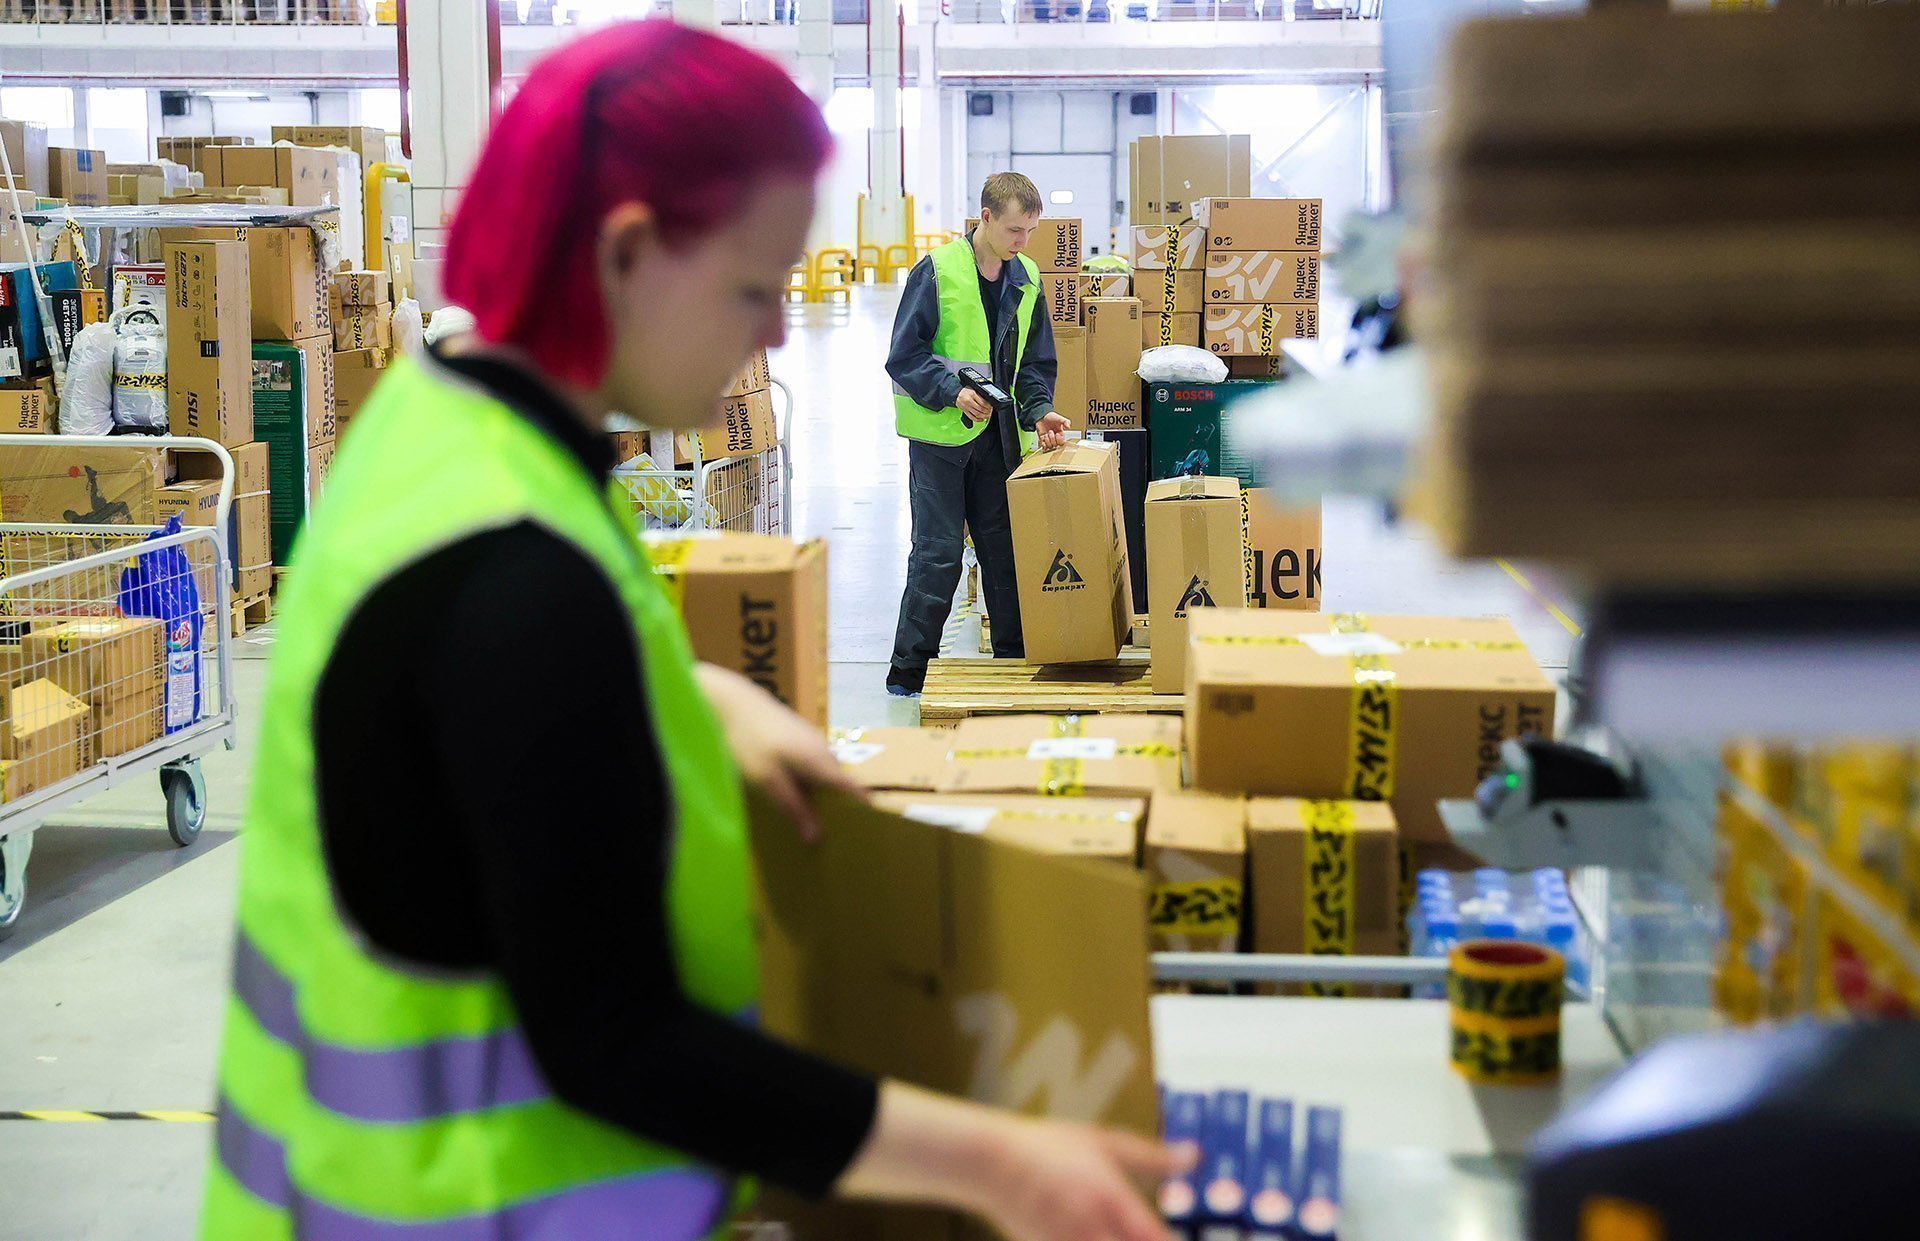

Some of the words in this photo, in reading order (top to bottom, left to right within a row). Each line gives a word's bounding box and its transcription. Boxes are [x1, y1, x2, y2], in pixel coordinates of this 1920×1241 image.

[1054, 224, 1067, 267] Яндекс
[1066, 223, 1079, 268] Маркет
[1295, 203, 1308, 246] Яндекс
[1307, 202, 1320, 246] Маркет
[1293, 257, 1306, 299] Яндекс
[1305, 256, 1318, 299] Маркет
[1053, 279, 1065, 322] Яндекс
[1065, 278, 1078, 322] Маркет
[62, 299, 72, 348] GET-1500SL
[18, 395, 29, 429] Яндекс
[29, 394, 39, 429] Маркет
[187, 391, 198, 427] msi
[1088, 400, 1135, 413] Яндекс
[1174, 390, 1214, 401] BOSCH
[725, 404, 740, 451] Яндекс
[737, 401, 753, 450] Маркет
[1088, 412, 1137, 427] Маркет
[1042, 584, 1086, 592] бюрократ
